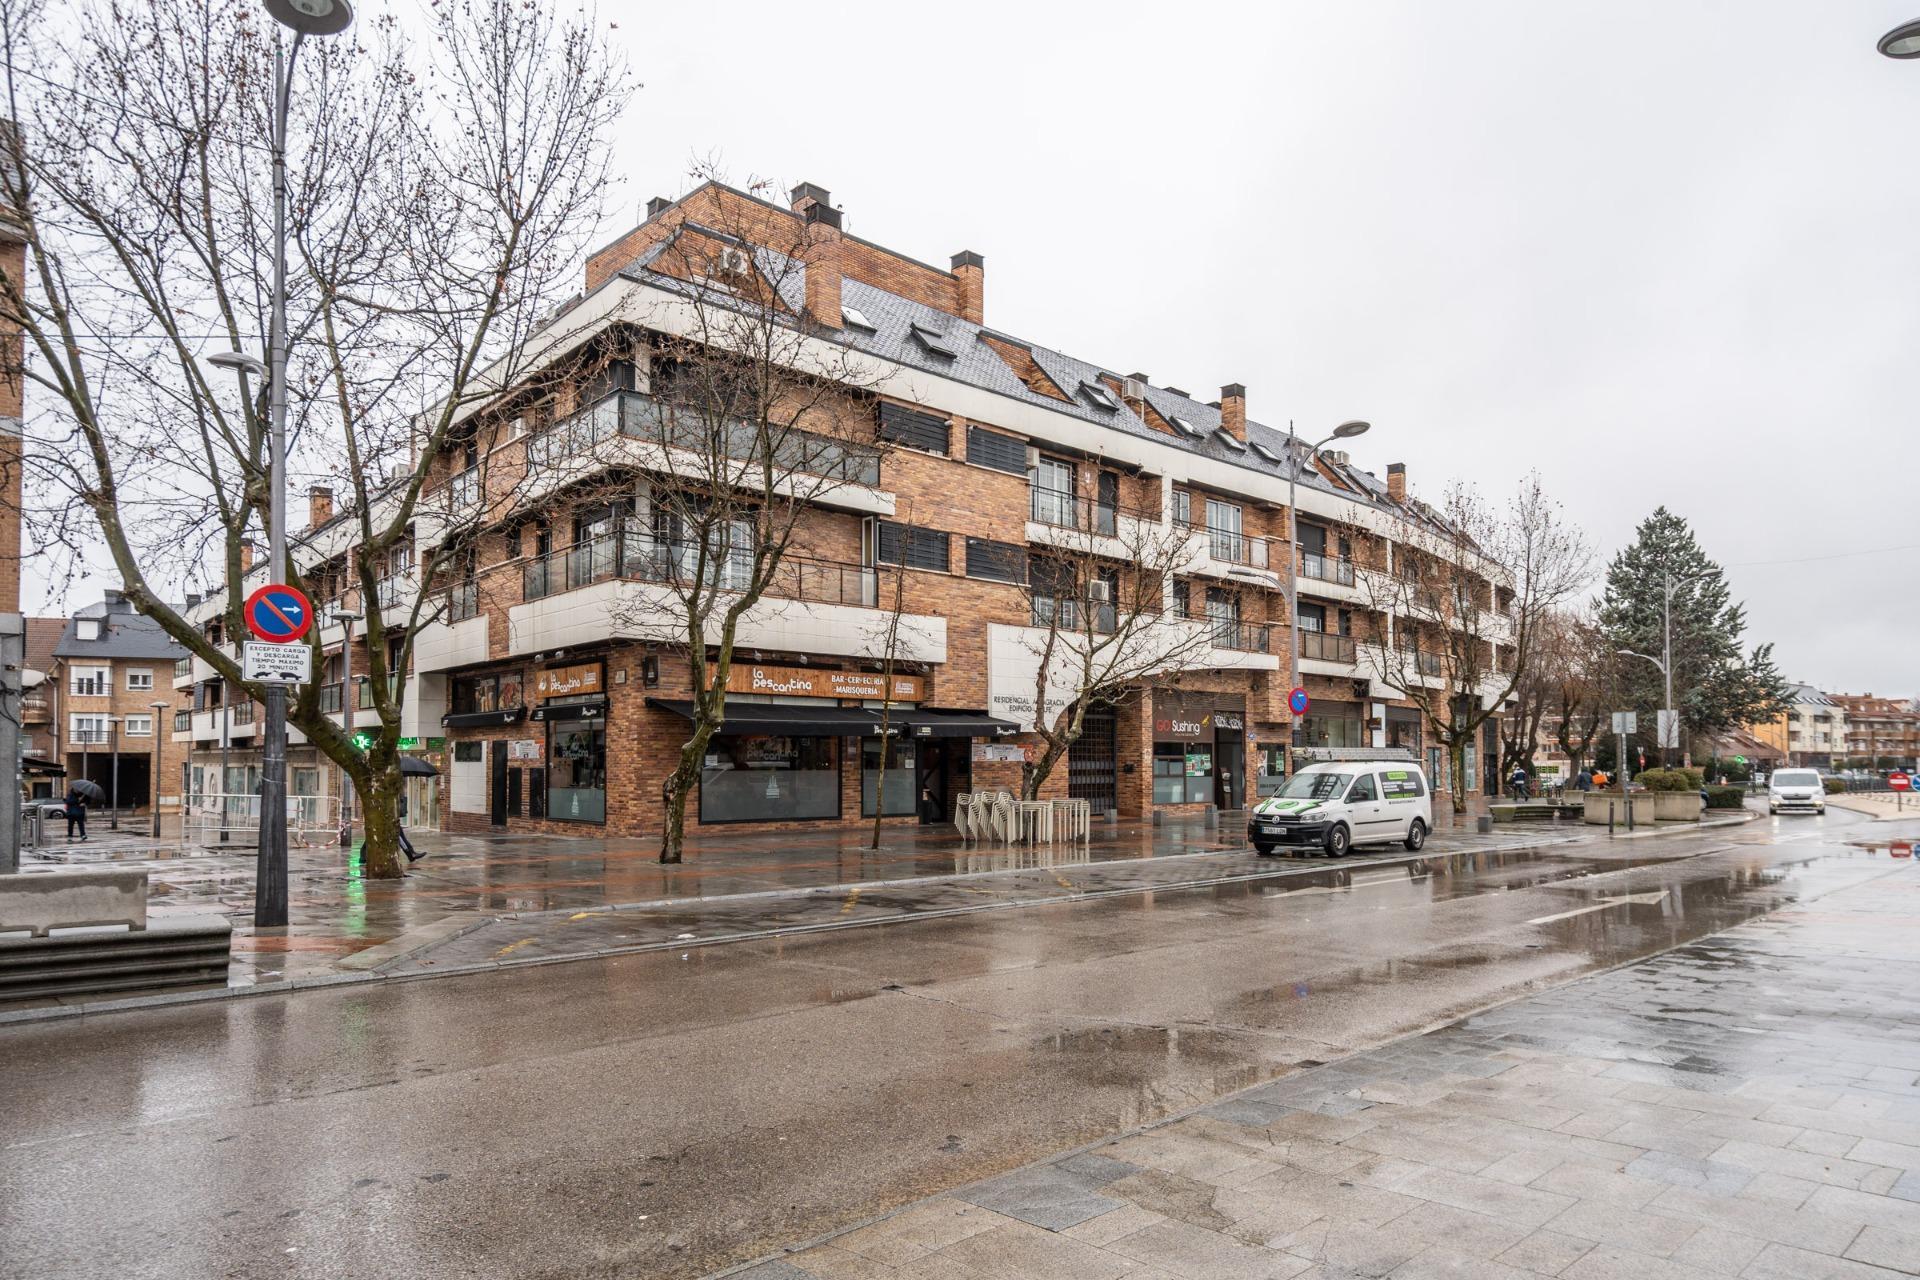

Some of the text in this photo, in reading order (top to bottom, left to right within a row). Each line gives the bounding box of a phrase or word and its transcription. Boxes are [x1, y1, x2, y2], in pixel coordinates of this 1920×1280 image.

[753, 667, 764, 679] la
[753, 678, 812, 692] pescantina
[993, 695, 1030, 705] RESIDENCIAL
[1009, 704, 1032, 713] EDIFICIO
[1172, 719, 1200, 736] Sushing
